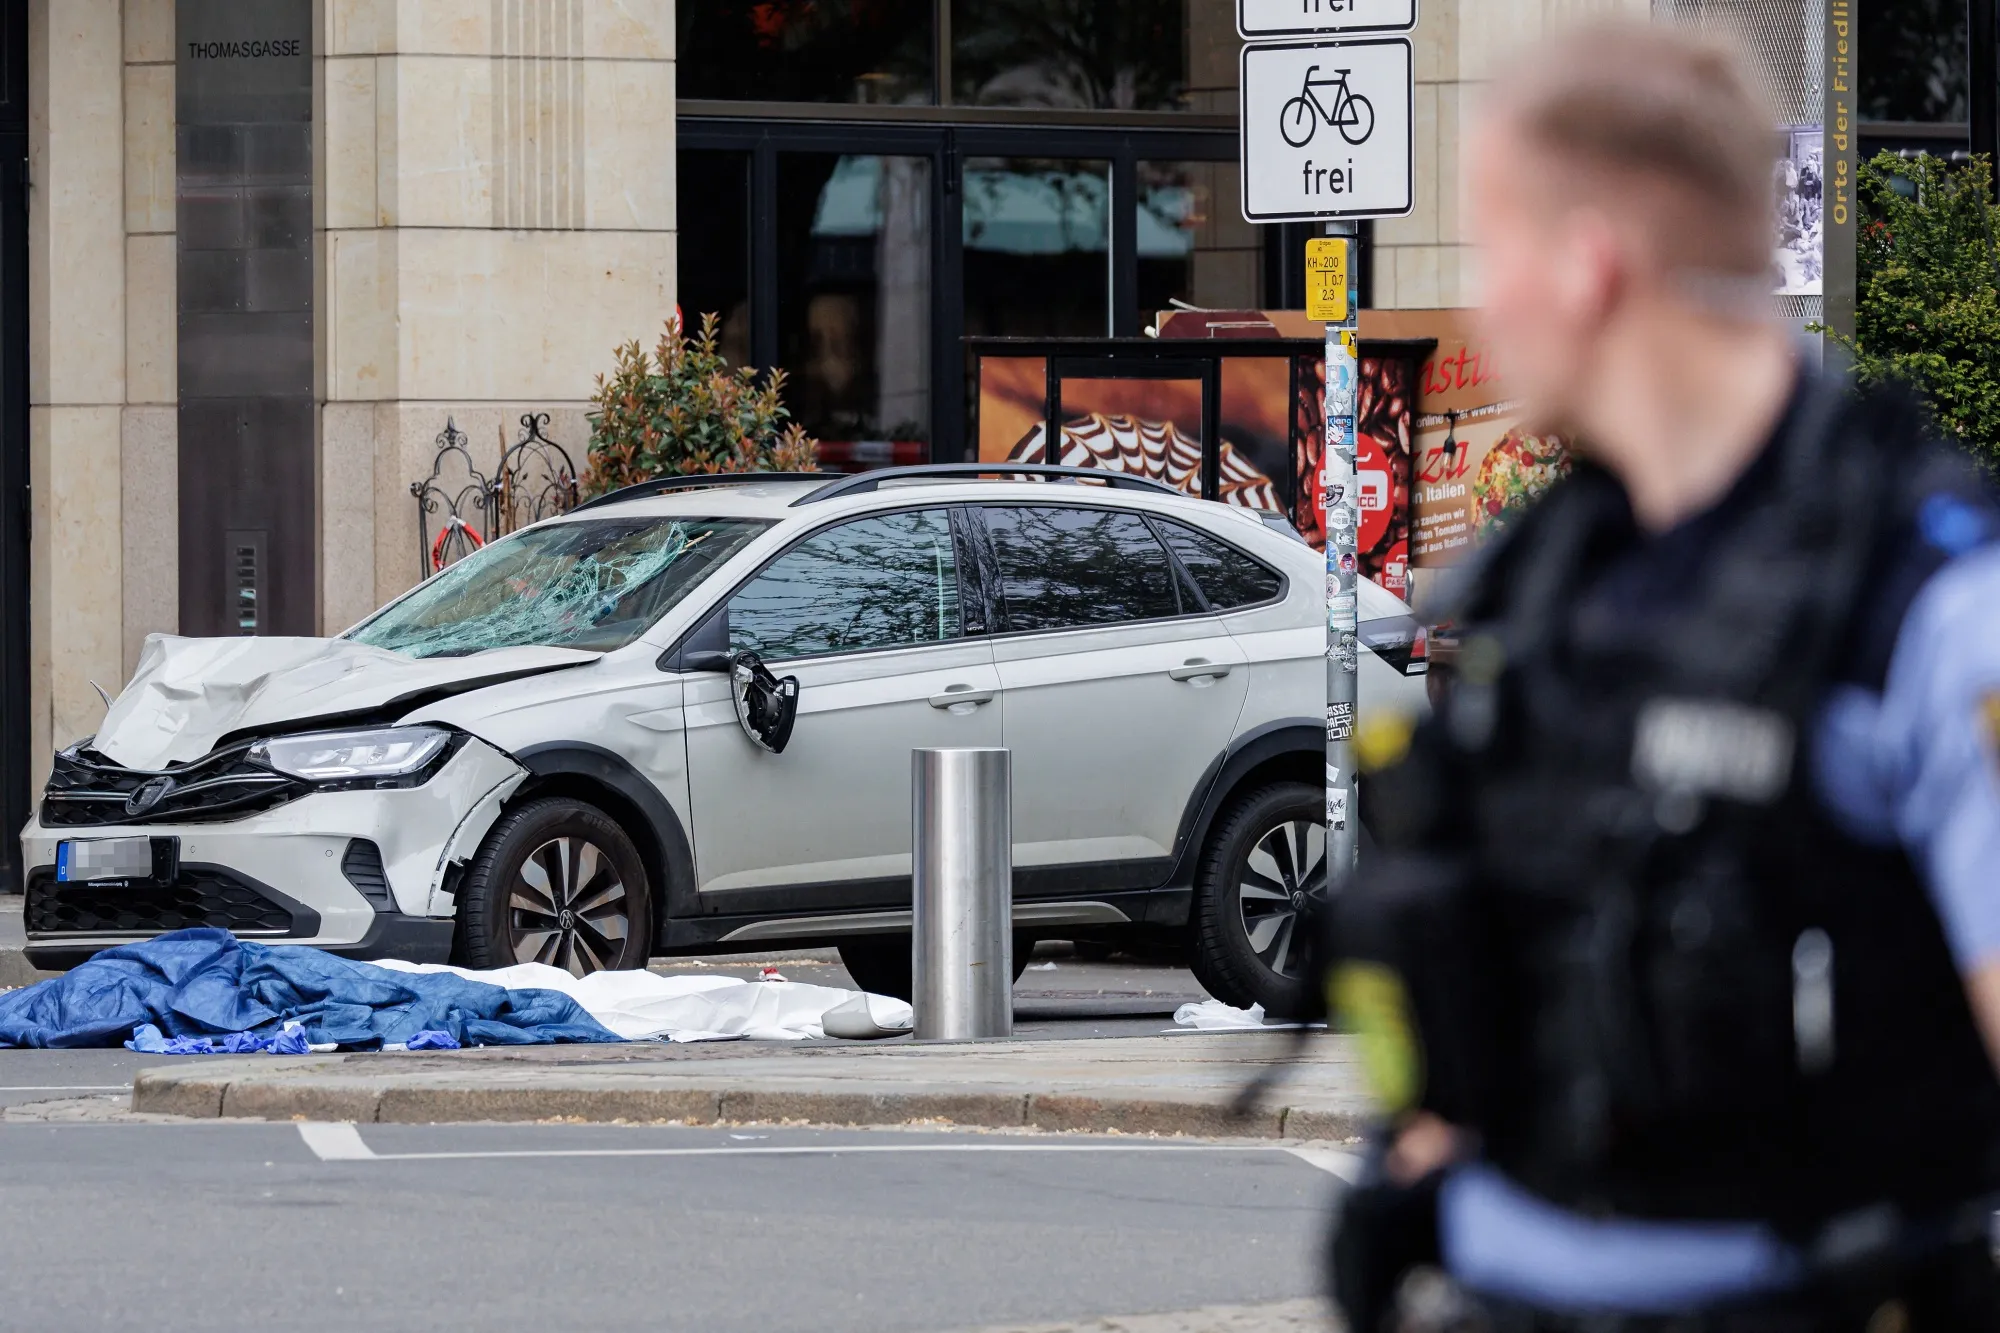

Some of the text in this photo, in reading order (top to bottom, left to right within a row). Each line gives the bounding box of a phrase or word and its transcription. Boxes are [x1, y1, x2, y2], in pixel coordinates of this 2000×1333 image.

[188, 40, 300, 58] THOMASGASSE
[1833, 102, 1848, 151] der
[1303, 158, 1353, 195] frei
[1833, 160, 1848, 225] Orte
[1307, 257, 1318, 268] KH
[1323, 256, 1339, 268] 200
[1416, 414, 1444, 428] online
[1426, 483, 1466, 503] Italien
[1420, 512, 1452, 526] zaubern
[1453, 508, 1466, 519] wir
[1433, 523, 1467, 538] Tomaten
[1429, 542, 1443, 552] aus
[1444, 536, 1468, 549] Italien
